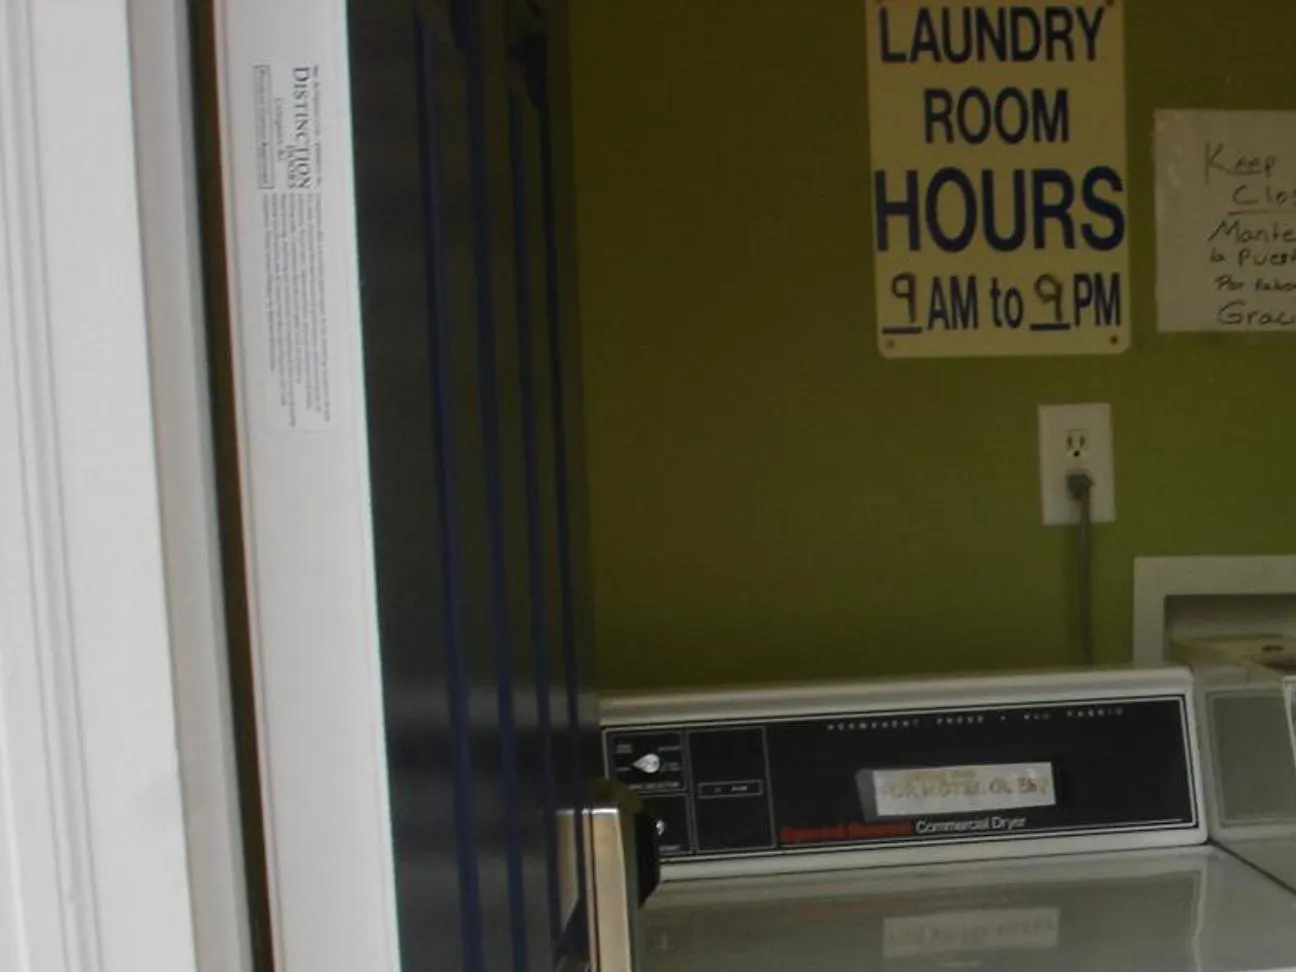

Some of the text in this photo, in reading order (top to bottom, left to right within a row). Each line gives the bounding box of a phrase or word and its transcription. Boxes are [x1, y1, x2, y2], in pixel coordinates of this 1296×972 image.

[879, 6, 1105, 63] LAUNDRY
[923, 86, 1070, 145] ROOM
[1203, 141, 1277, 185] Keep
[874, 165, 1125, 253] HOURS
[891, 272, 1122, 330] 9 AM to 9 PM
